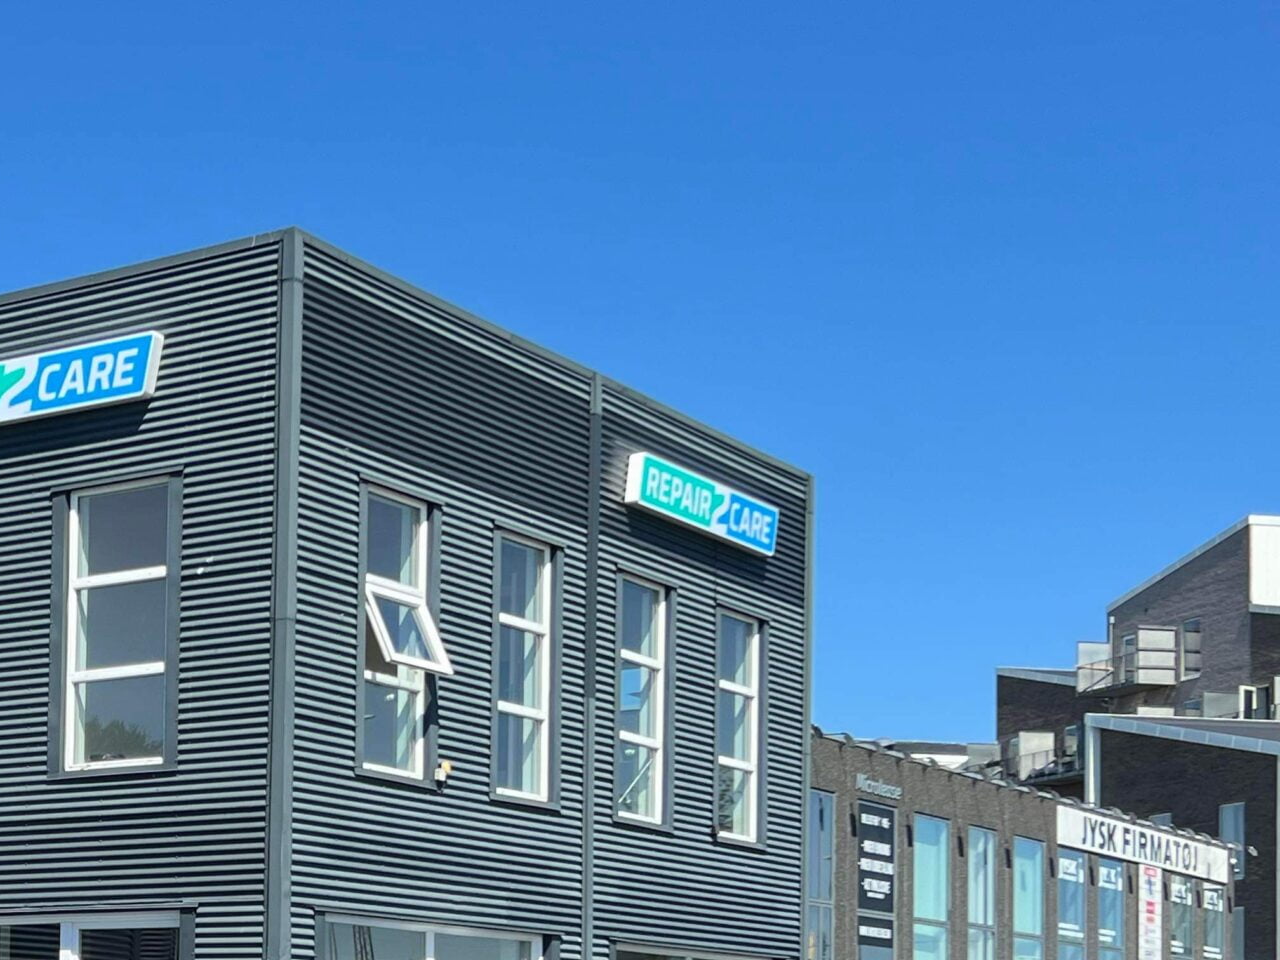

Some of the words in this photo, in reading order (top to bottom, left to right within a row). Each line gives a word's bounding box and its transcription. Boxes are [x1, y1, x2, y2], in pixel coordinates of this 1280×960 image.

[646, 467, 773, 545] REPAIR2CARE
[1082, 816, 1117, 853] JYSK
[1123, 827, 1198, 872] FIRMATØJ
